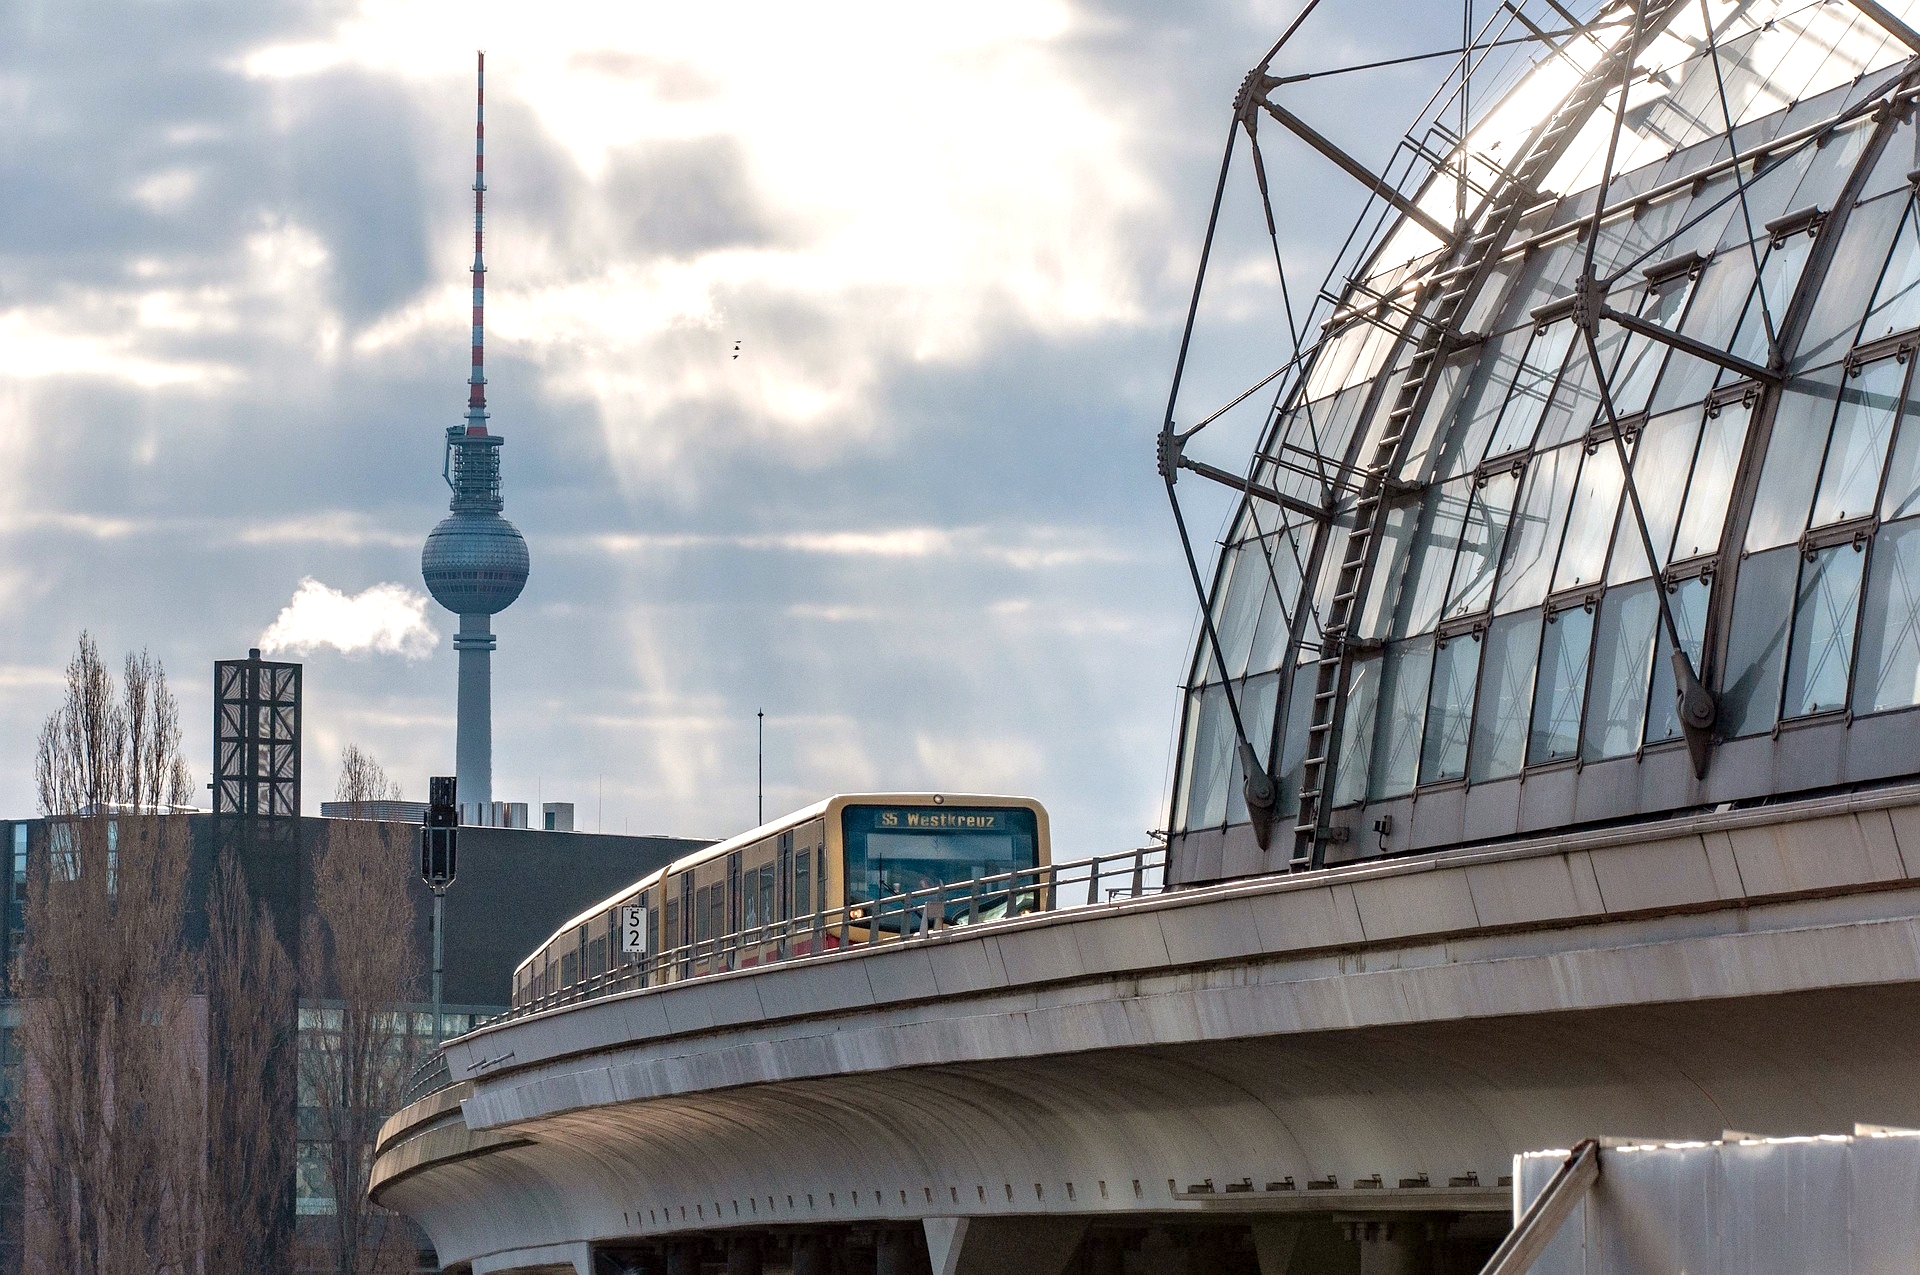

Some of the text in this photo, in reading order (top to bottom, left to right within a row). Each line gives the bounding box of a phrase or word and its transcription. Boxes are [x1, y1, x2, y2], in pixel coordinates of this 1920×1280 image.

[882, 812, 995, 828] S5 Westkreuz
[629, 911, 640, 928] 5
[629, 930, 640, 947] 2
